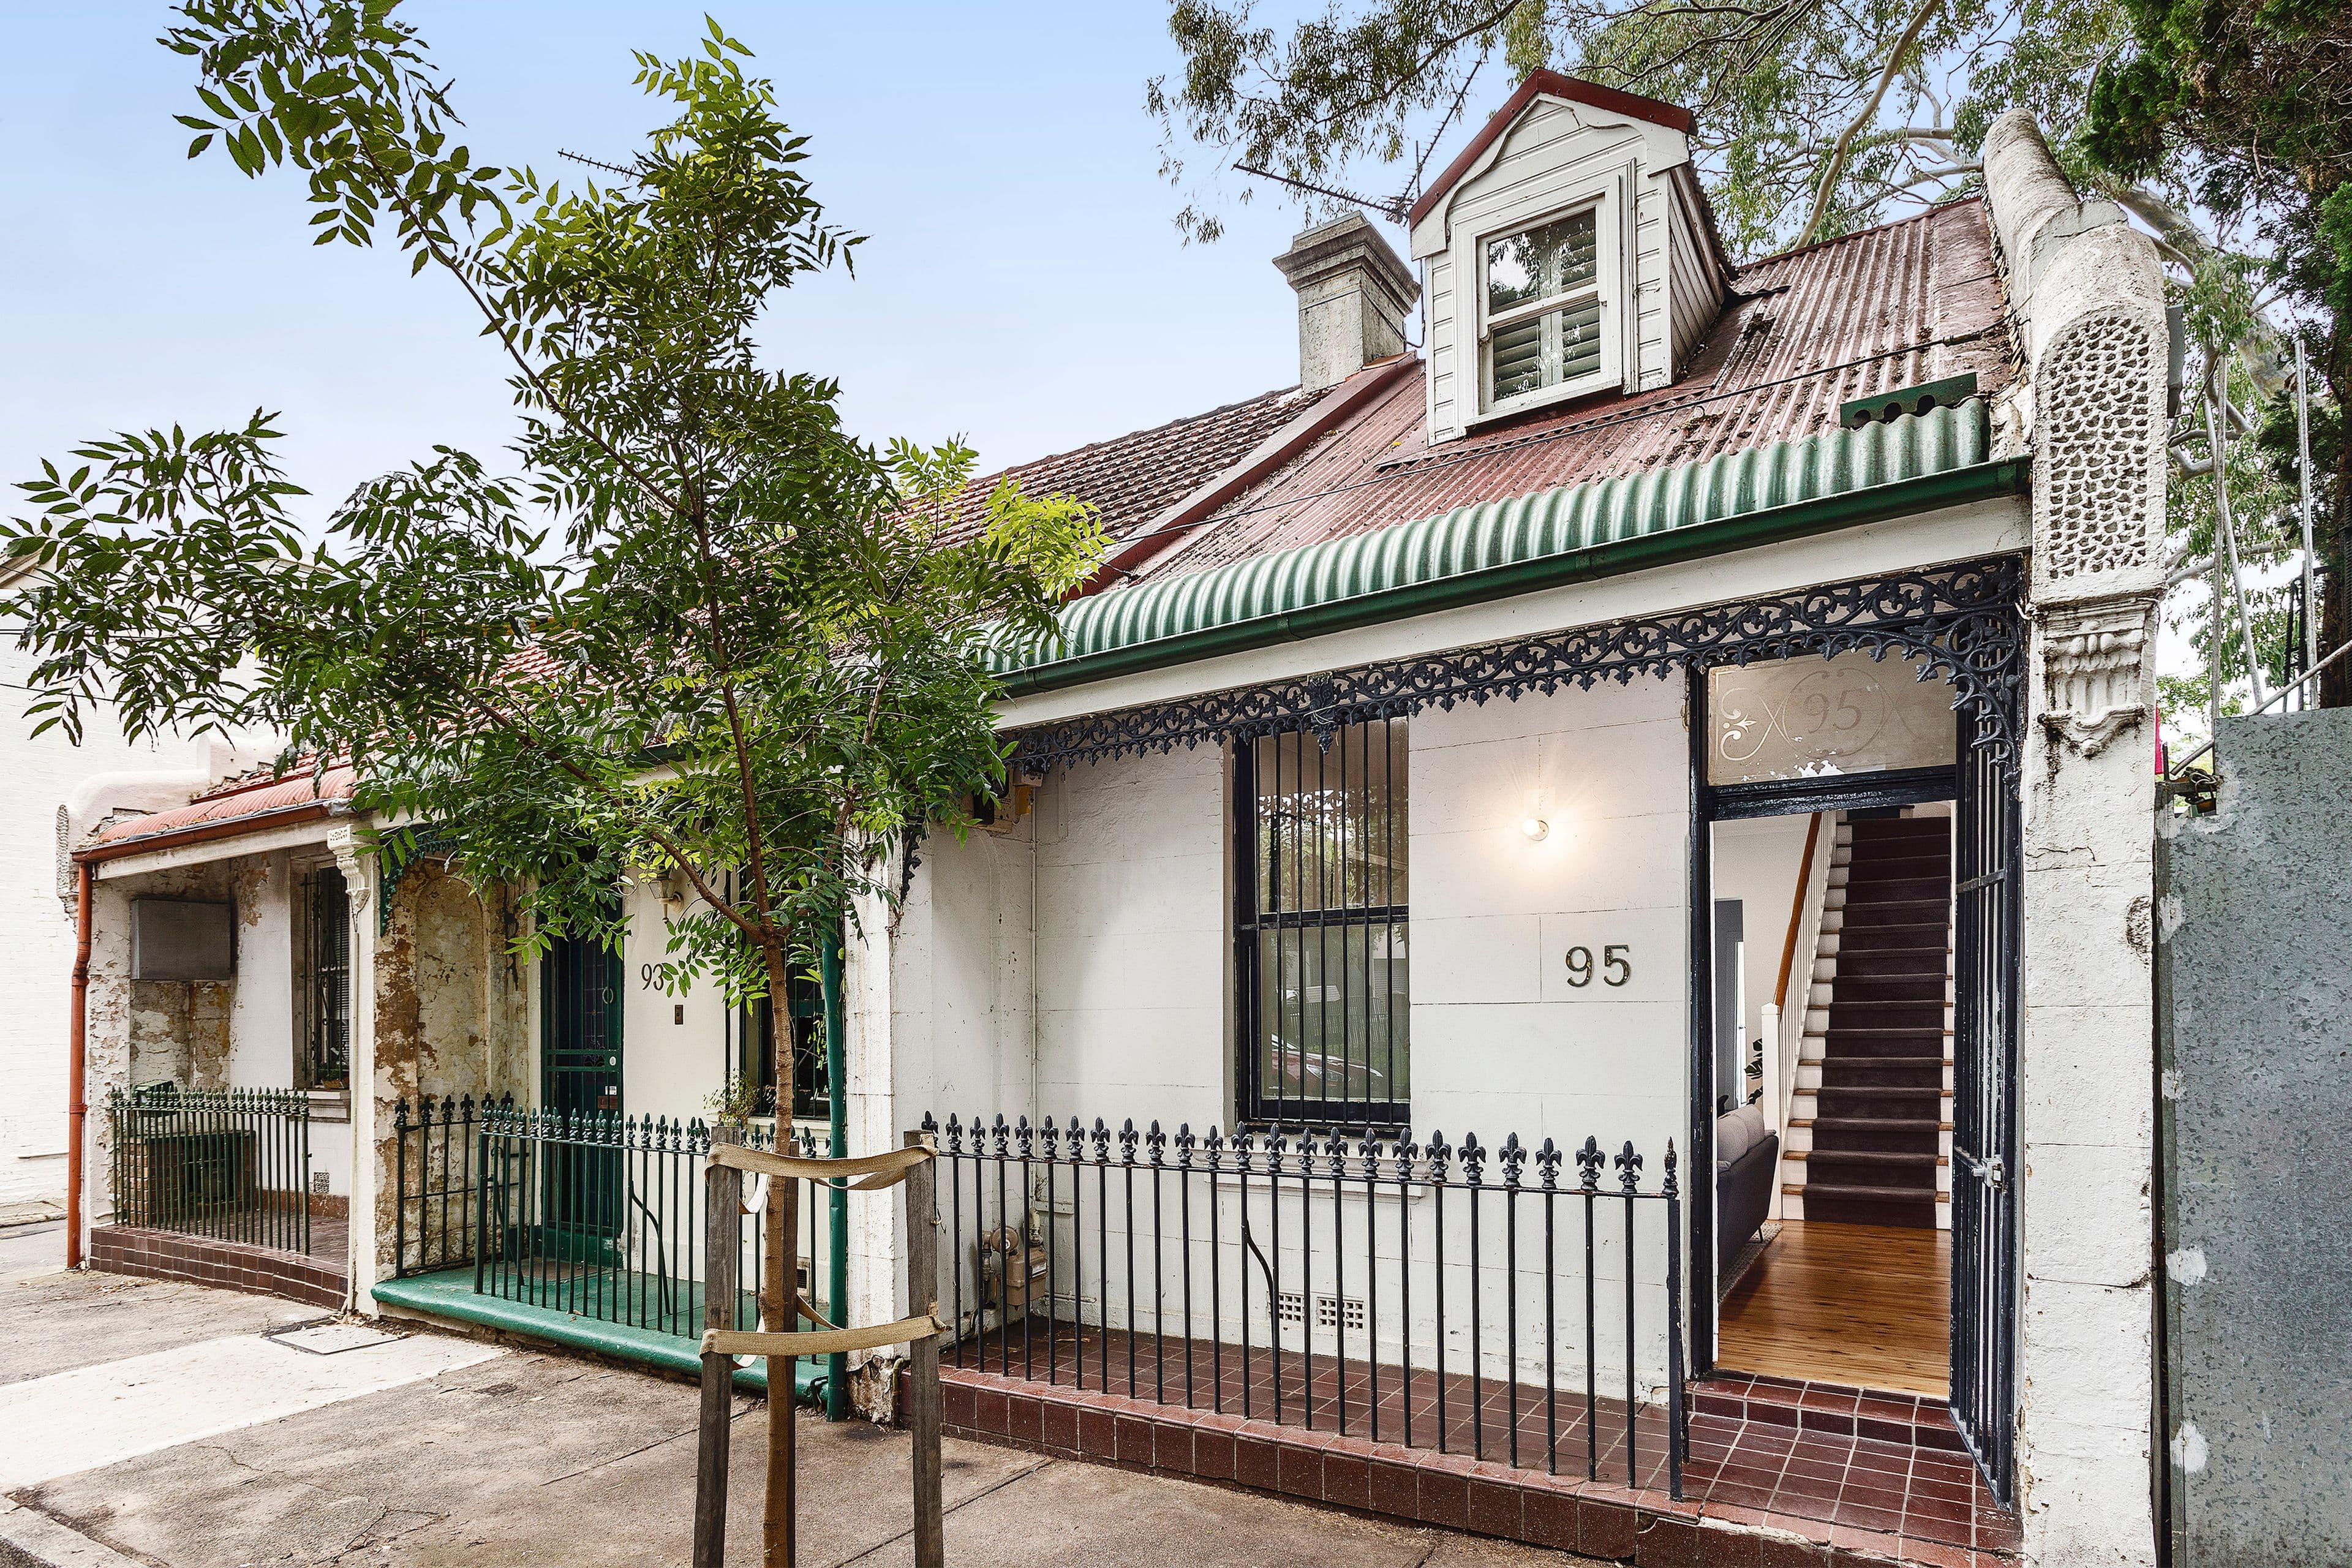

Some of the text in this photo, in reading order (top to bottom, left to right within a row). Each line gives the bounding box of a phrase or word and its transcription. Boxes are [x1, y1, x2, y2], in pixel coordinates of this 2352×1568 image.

[1803, 687, 1867, 733] 95
[641, 963, 663, 990] 93
[1566, 944, 1630, 987] 95
